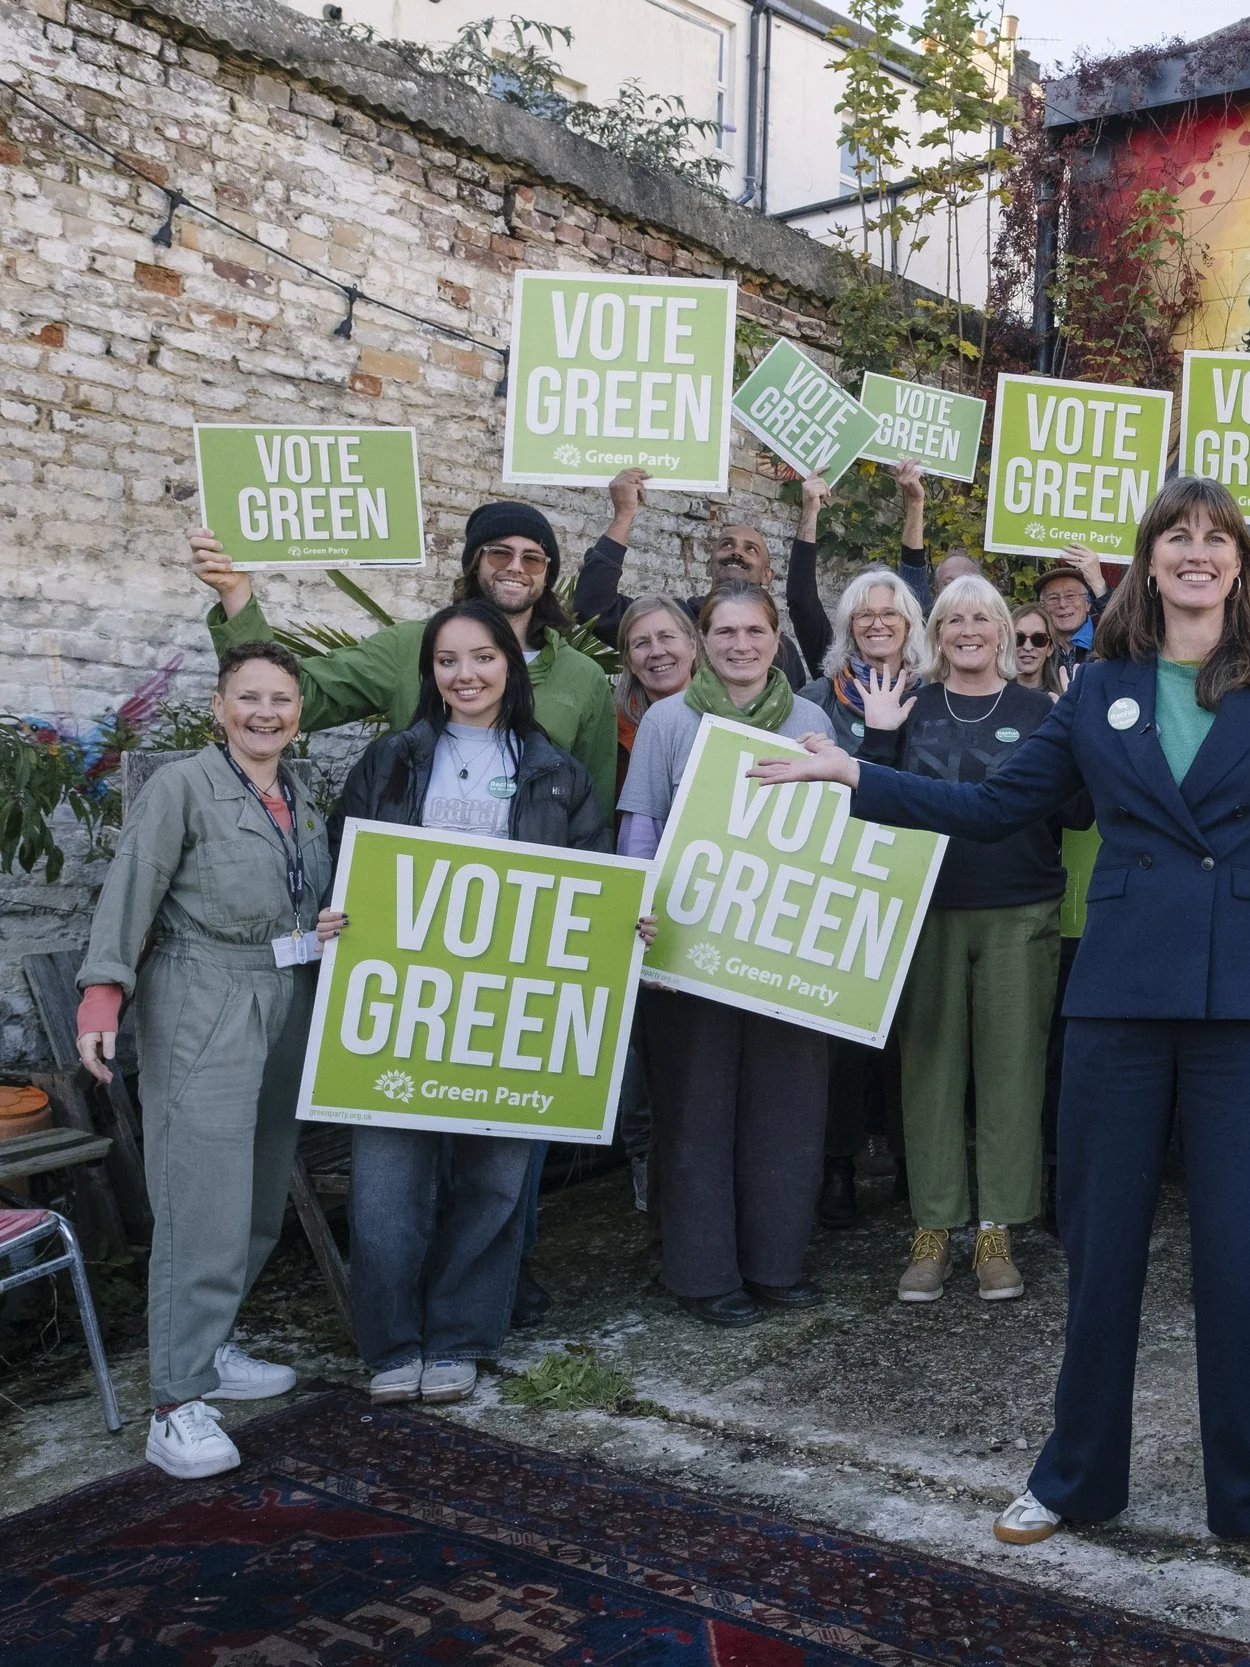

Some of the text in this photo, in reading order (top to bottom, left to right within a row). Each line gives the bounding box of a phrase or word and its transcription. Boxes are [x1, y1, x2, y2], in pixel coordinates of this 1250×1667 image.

[552, 291, 697, 365] VOTE
[526, 366, 712, 442] GREEN
[783, 361, 858, 437] VOTE
[895, 385, 954, 426] VOTE
[750, 386, 841, 468] GREEN
[875, 412, 960, 462] GREEN
[1027, 393, 1141, 461] VOTE
[255, 435, 363, 483] VOTE
[585, 450, 680, 471] Green Party
[238, 487, 389, 541] GREEN
[1004, 456, 1150, 525] GREEN
[303, 547, 349, 556] Green Party
[1049, 528, 1123, 547] Green Party
[396, 854, 602, 971] VOTE
[666, 839, 903, 981] GREEN
[725, 956, 839, 1007] Green Party
[340, 959, 610, 1077] GREEN
[309, 1109, 373, 1121] greenparty.org.uk
[421, 1080, 554, 1113] Green Party
